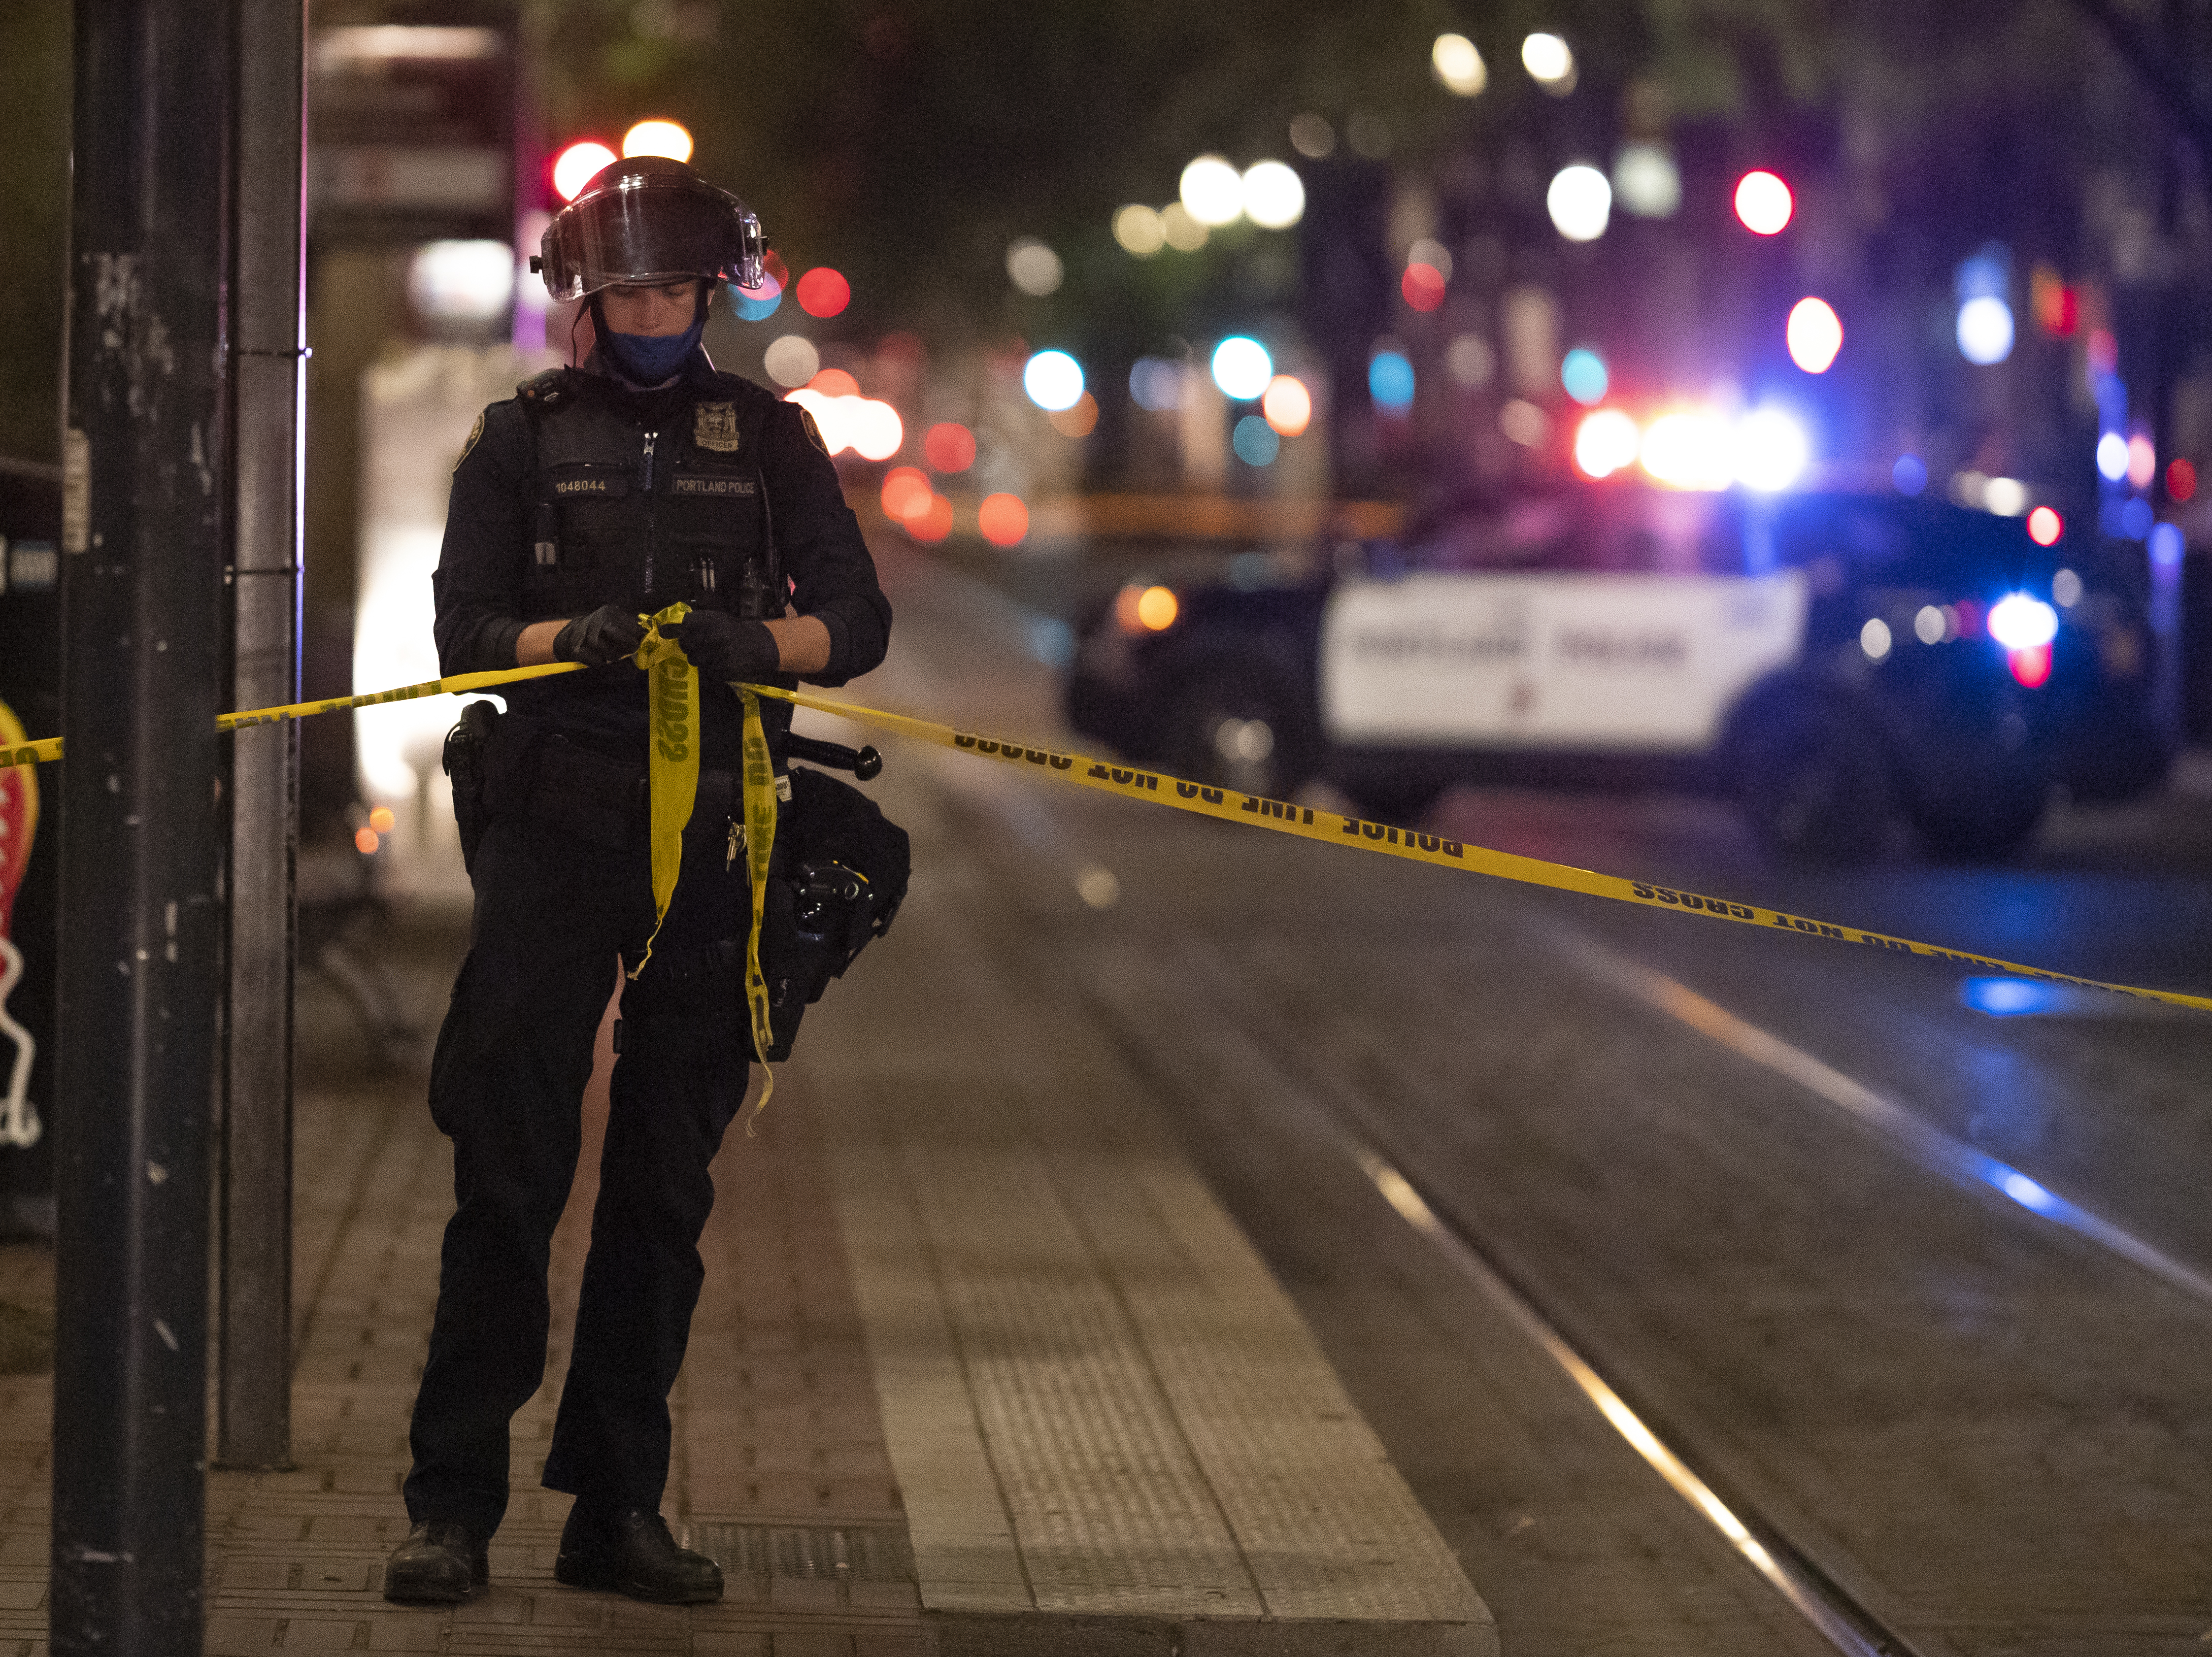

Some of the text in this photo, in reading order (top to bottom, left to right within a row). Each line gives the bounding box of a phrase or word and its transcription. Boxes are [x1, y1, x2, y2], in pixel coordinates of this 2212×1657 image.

[556, 480, 606, 493] 1048044
[676, 479, 754, 494] PORTLAND POLICE
[1631, 882, 1755, 920] CROSS
[1772, 915, 1845, 940] NOT
